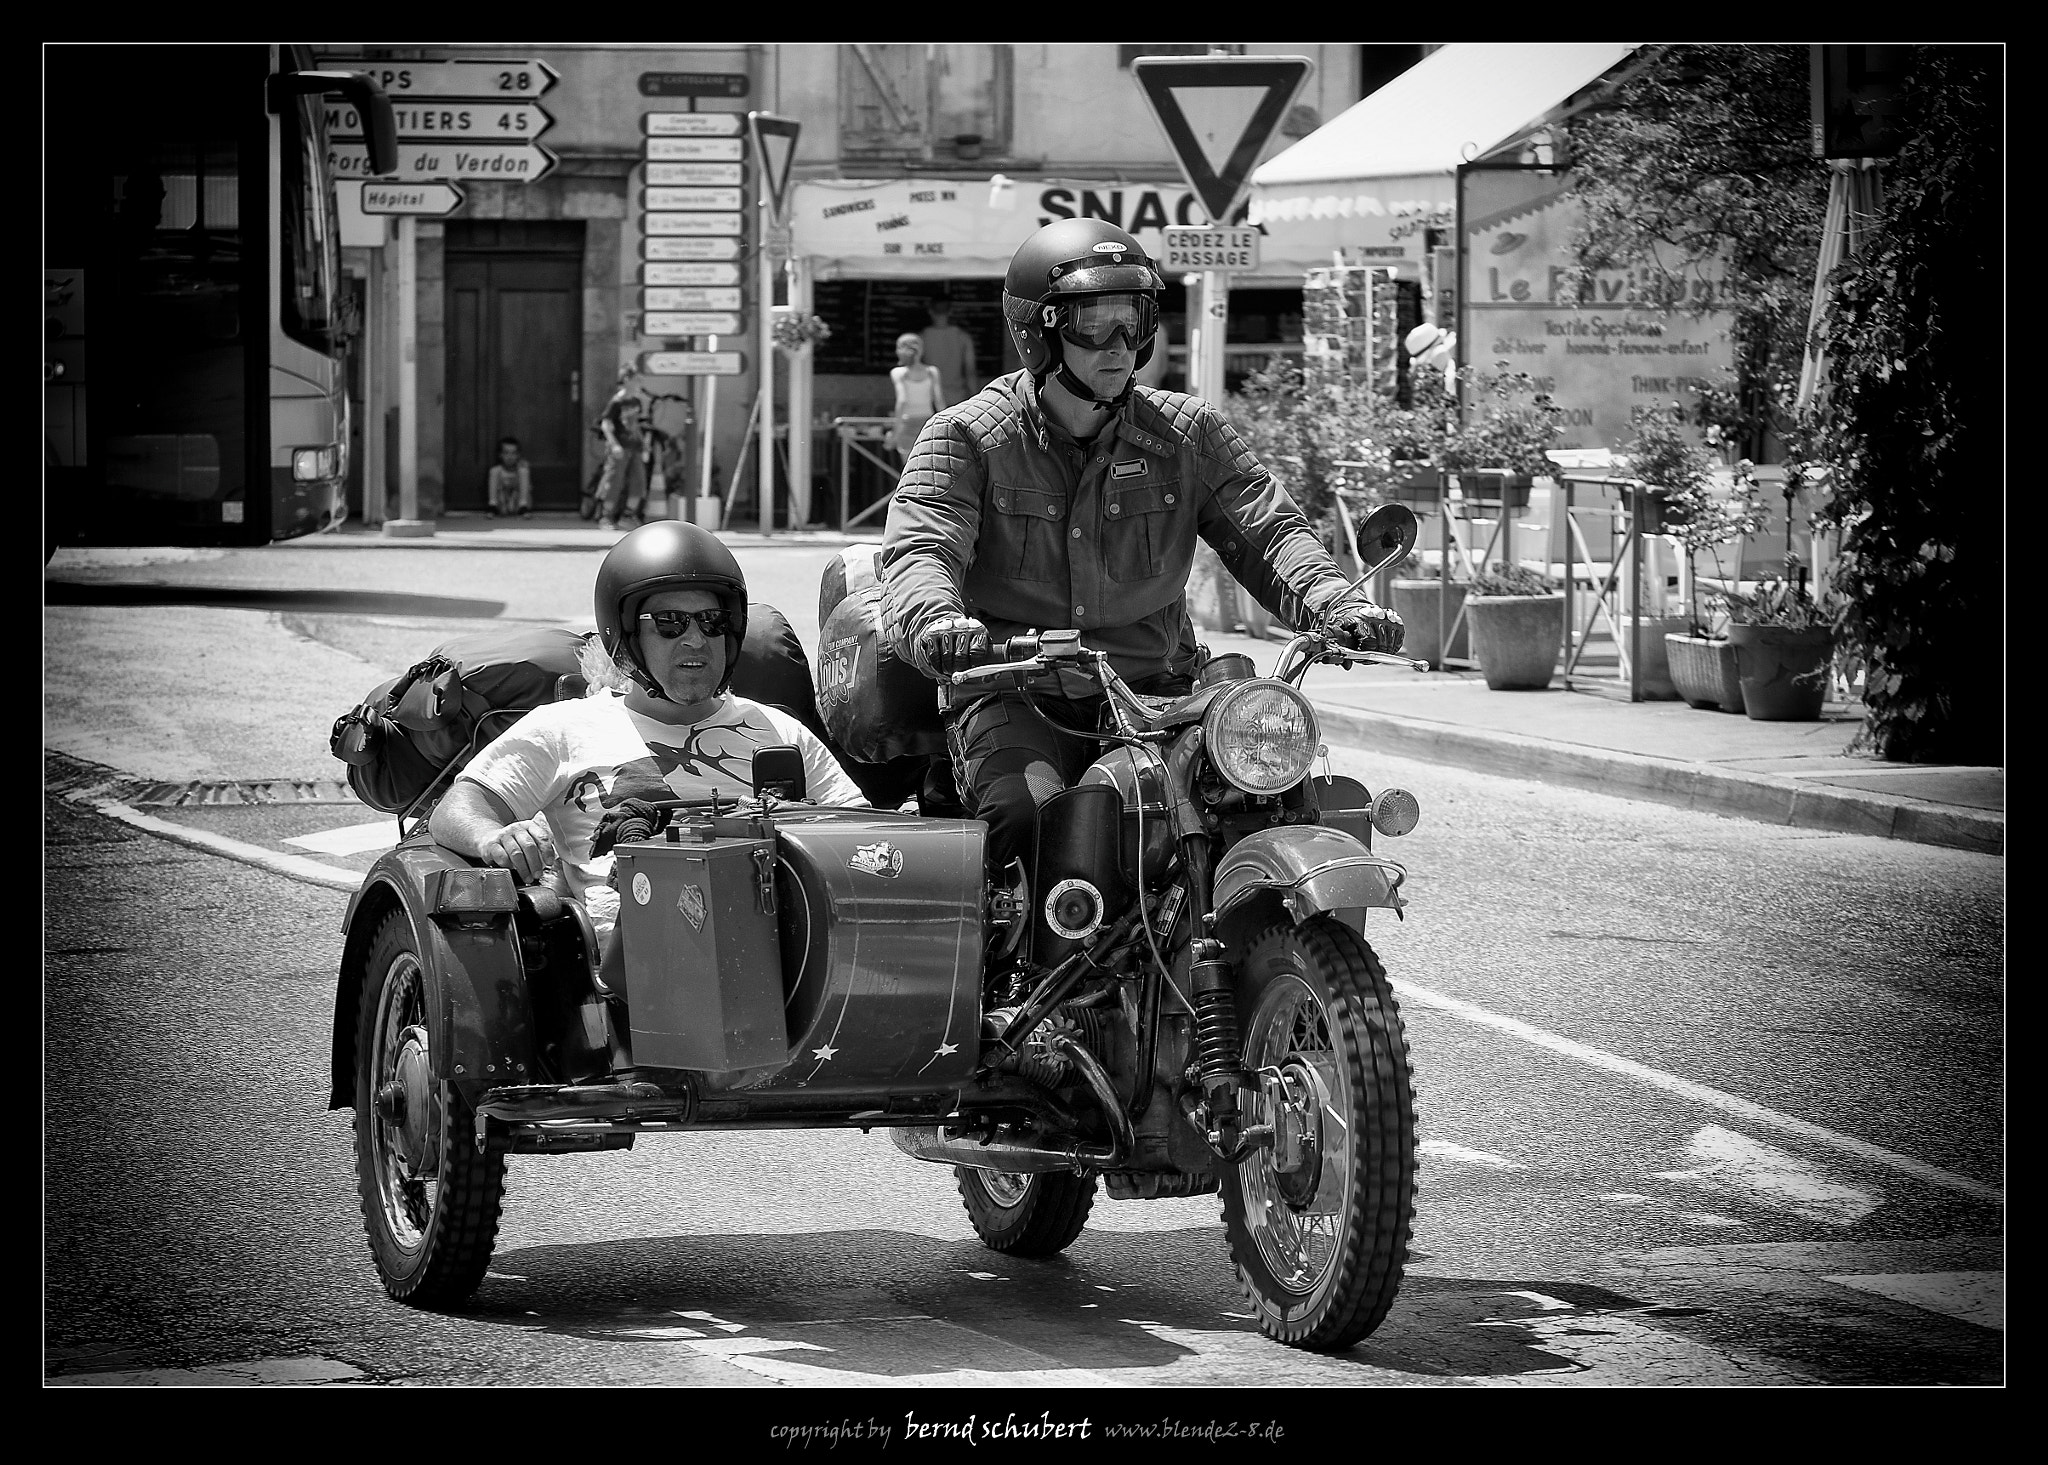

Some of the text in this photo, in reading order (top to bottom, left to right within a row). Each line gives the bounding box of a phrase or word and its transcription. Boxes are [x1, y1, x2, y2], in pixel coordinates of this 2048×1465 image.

[499, 72, 531, 90] 28
[324, 110, 529, 131] MOTIERS 45
[414, 152, 439, 172] du
[455, 152, 529, 172] Verdon
[368, 192, 425, 208] Hôpital
[914, 242, 944, 254] PLACE
[1232, 233, 1252, 248] LE
[1169, 251, 1249, 266] PASSAGE
[1488, 266, 1532, 301] Le
[835, 634, 859, 649] COMPANY
